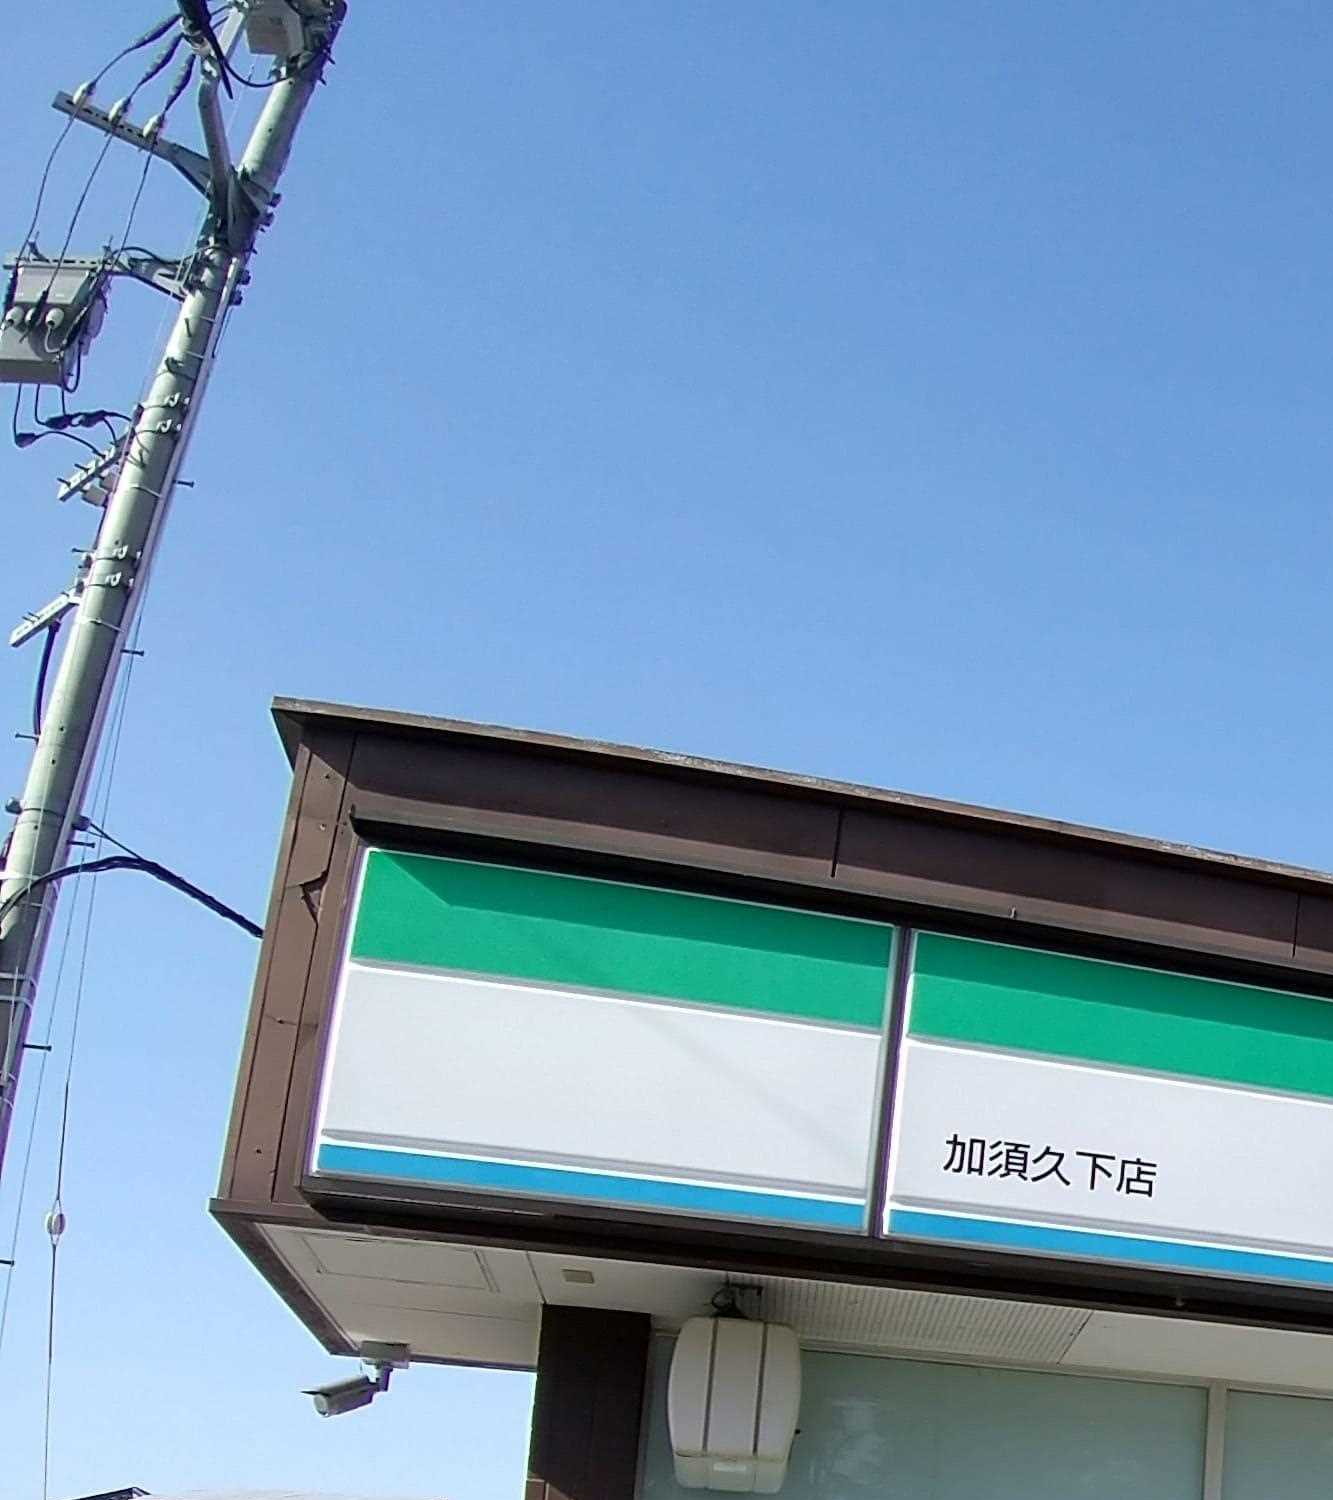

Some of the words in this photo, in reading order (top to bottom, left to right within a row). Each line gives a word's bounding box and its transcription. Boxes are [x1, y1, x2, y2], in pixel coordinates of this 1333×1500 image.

[943, 1133, 1157, 1197] 加須久下店
